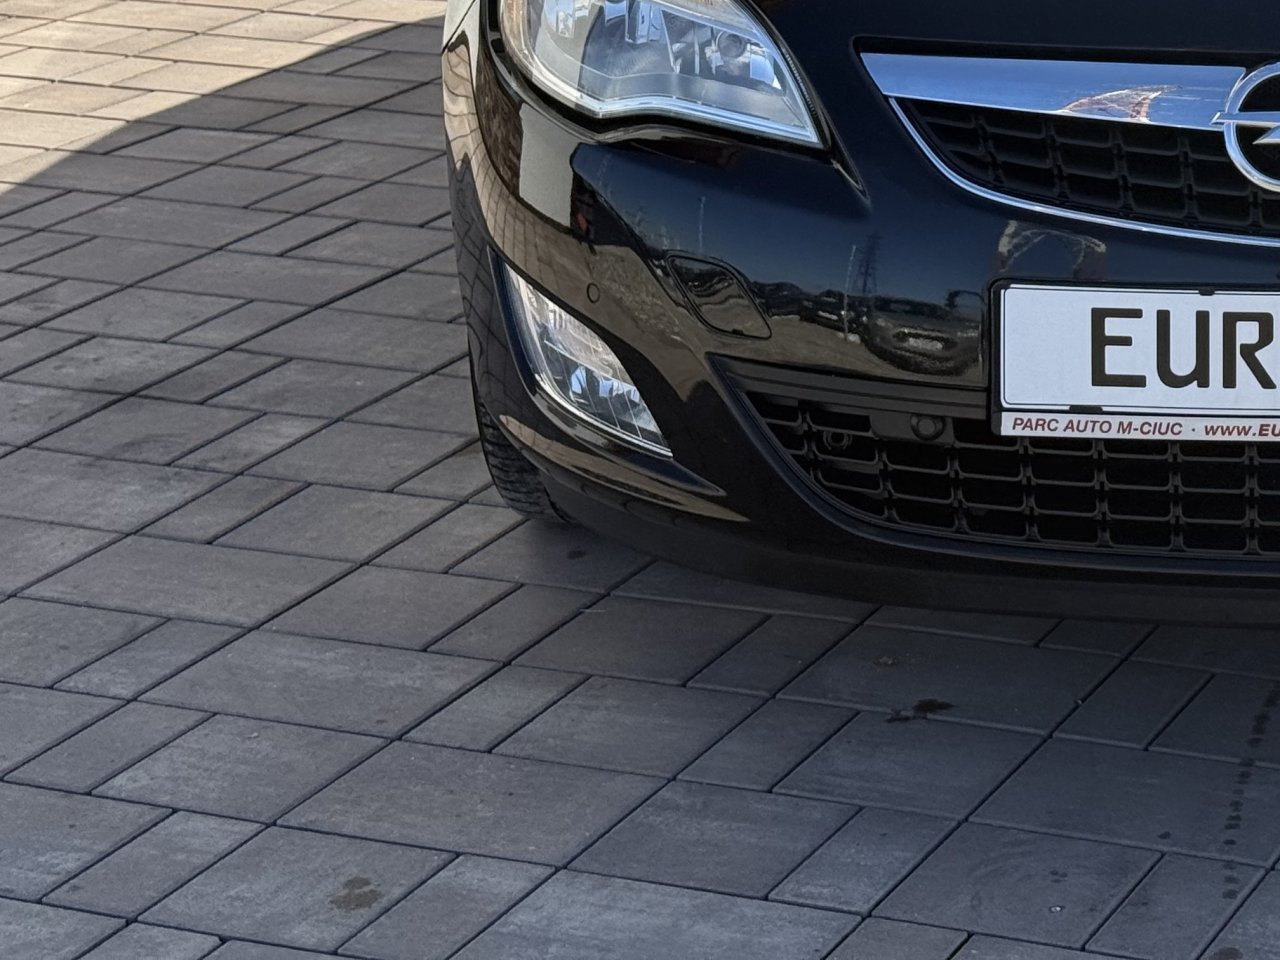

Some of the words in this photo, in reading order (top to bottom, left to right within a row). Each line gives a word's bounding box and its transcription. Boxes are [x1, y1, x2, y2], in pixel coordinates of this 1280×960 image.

[1012, 417, 1059, 432] PARC
[1063, 419, 1112, 434] AUTO
[1116, 420, 1183, 436] M-CIUC
